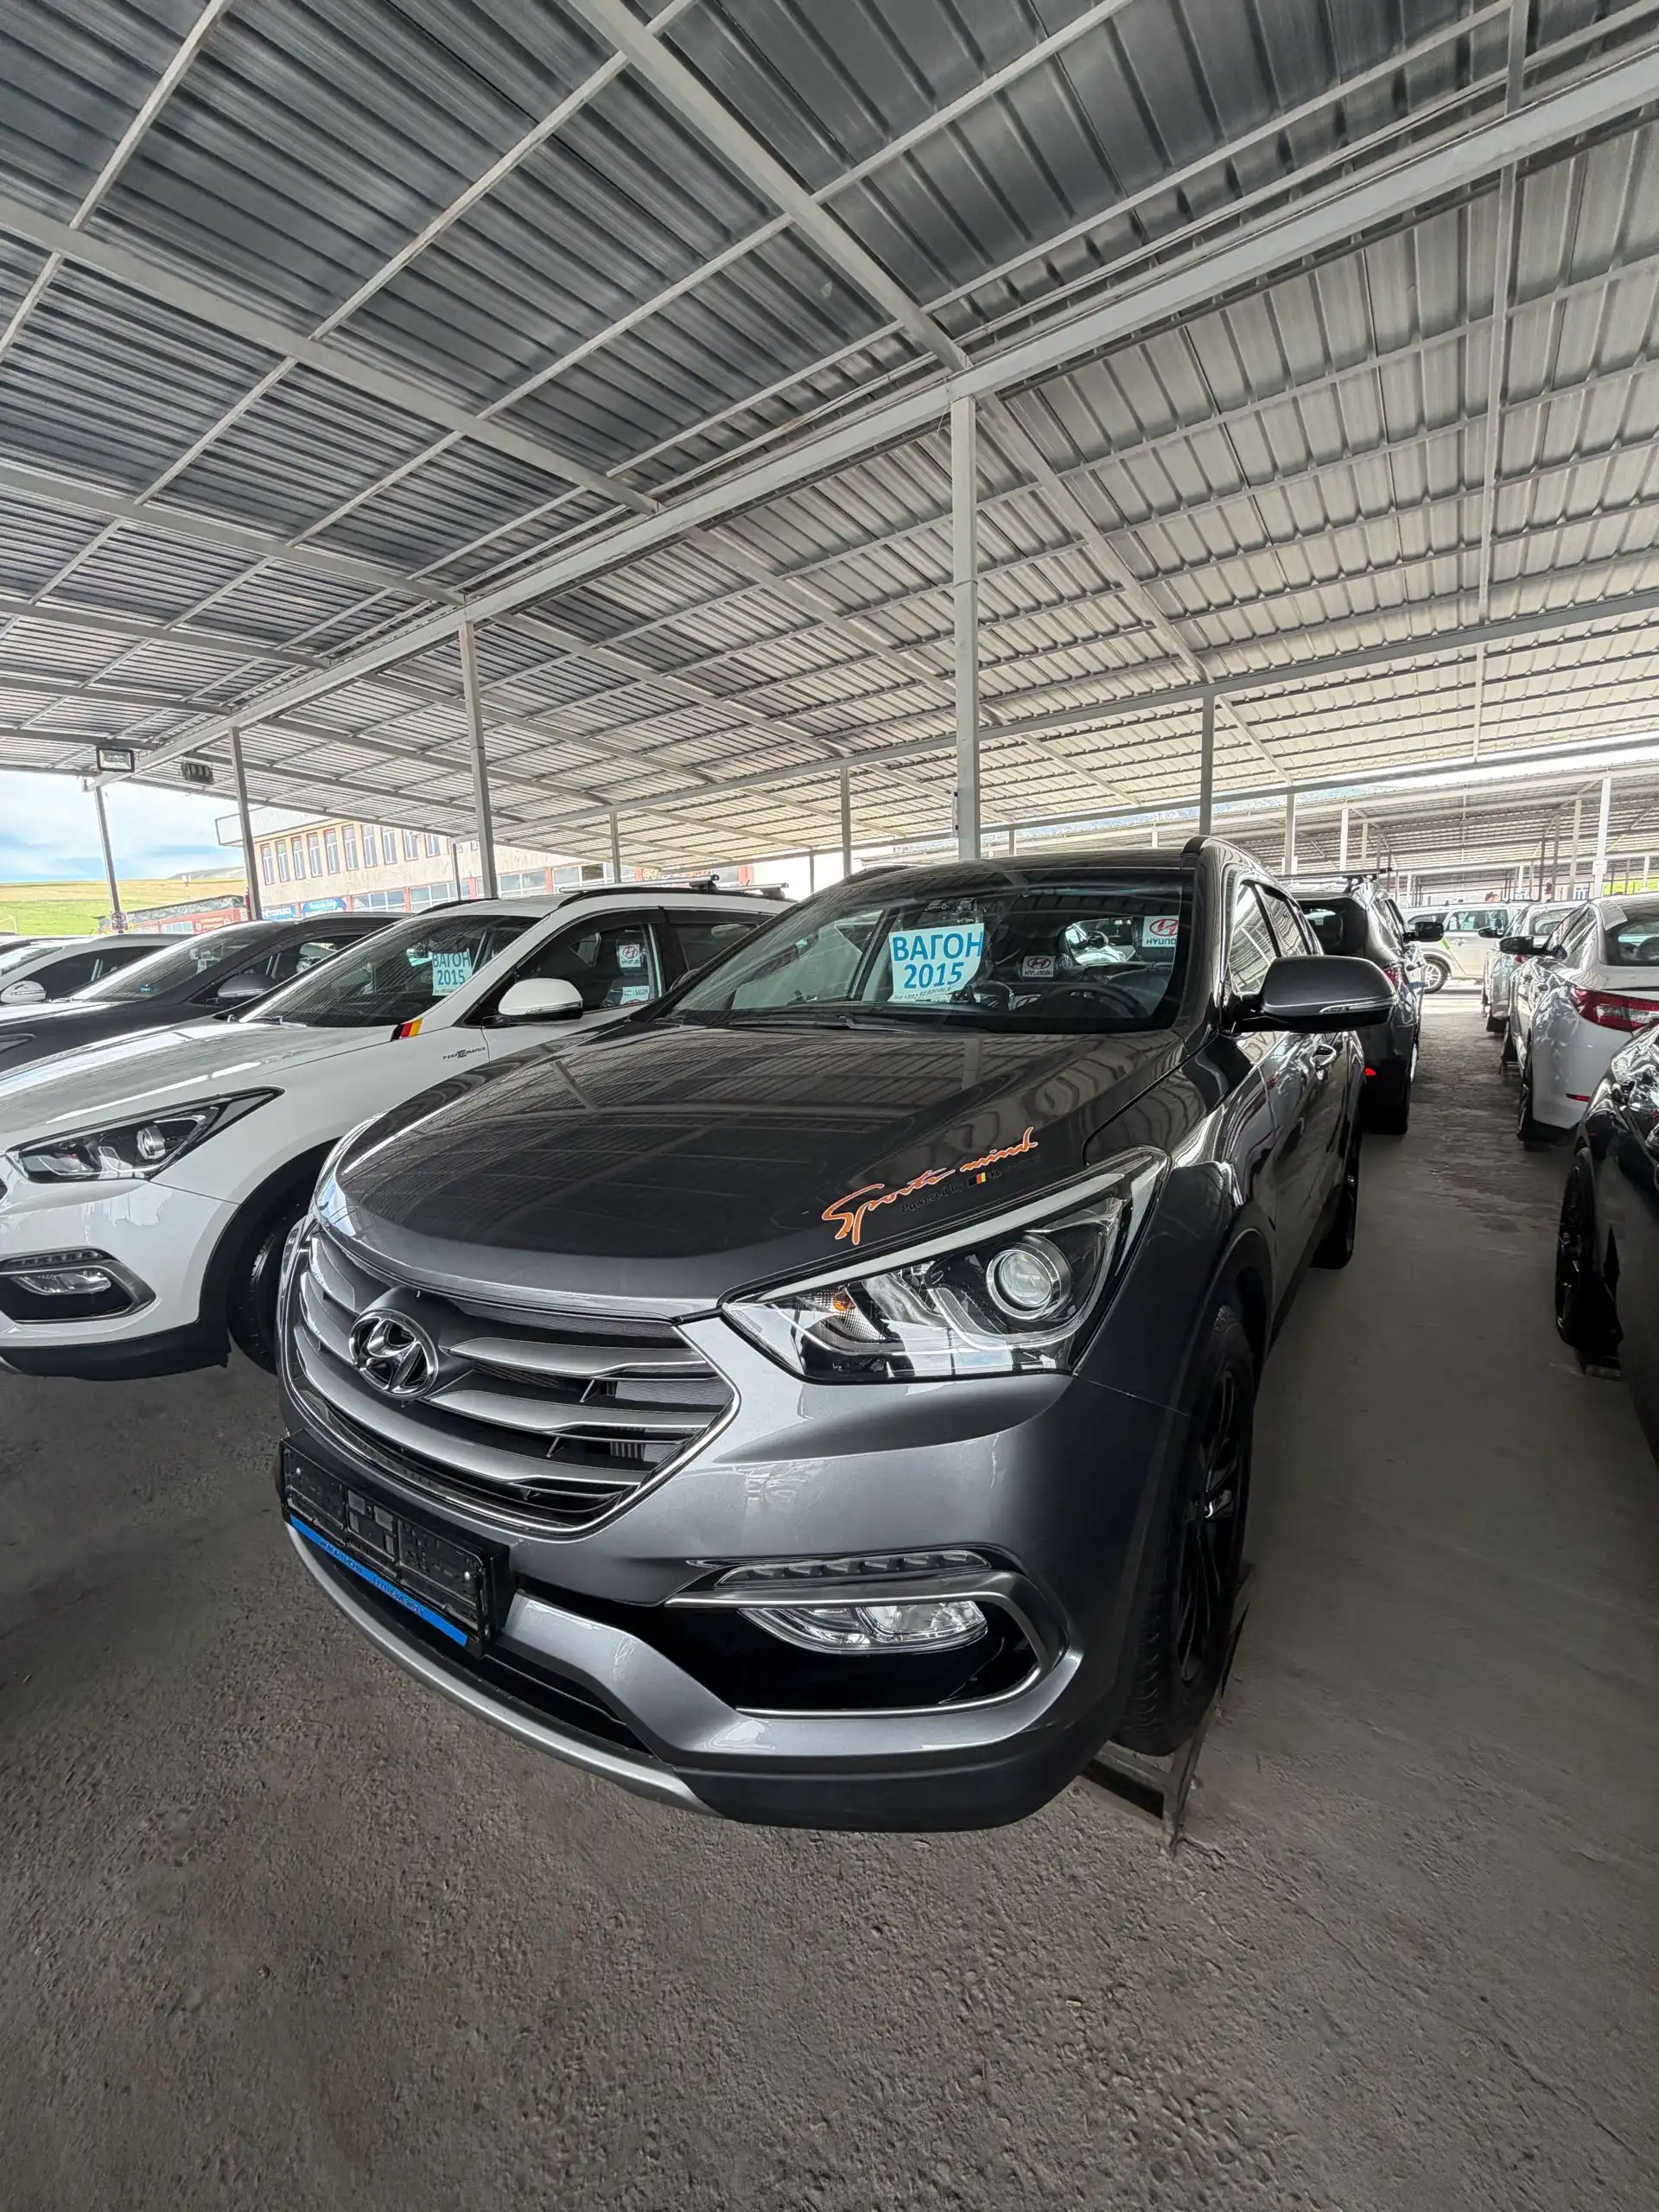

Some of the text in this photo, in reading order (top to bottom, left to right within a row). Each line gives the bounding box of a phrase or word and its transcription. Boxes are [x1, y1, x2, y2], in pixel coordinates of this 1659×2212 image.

[432, 951, 470, 968] ВАГОН
[893, 931, 983, 961] ВАГОН
[437, 969, 466, 985] 2015
[904, 962, 964, 989] 2015
[901, 1180, 965, 1213] Powered by
